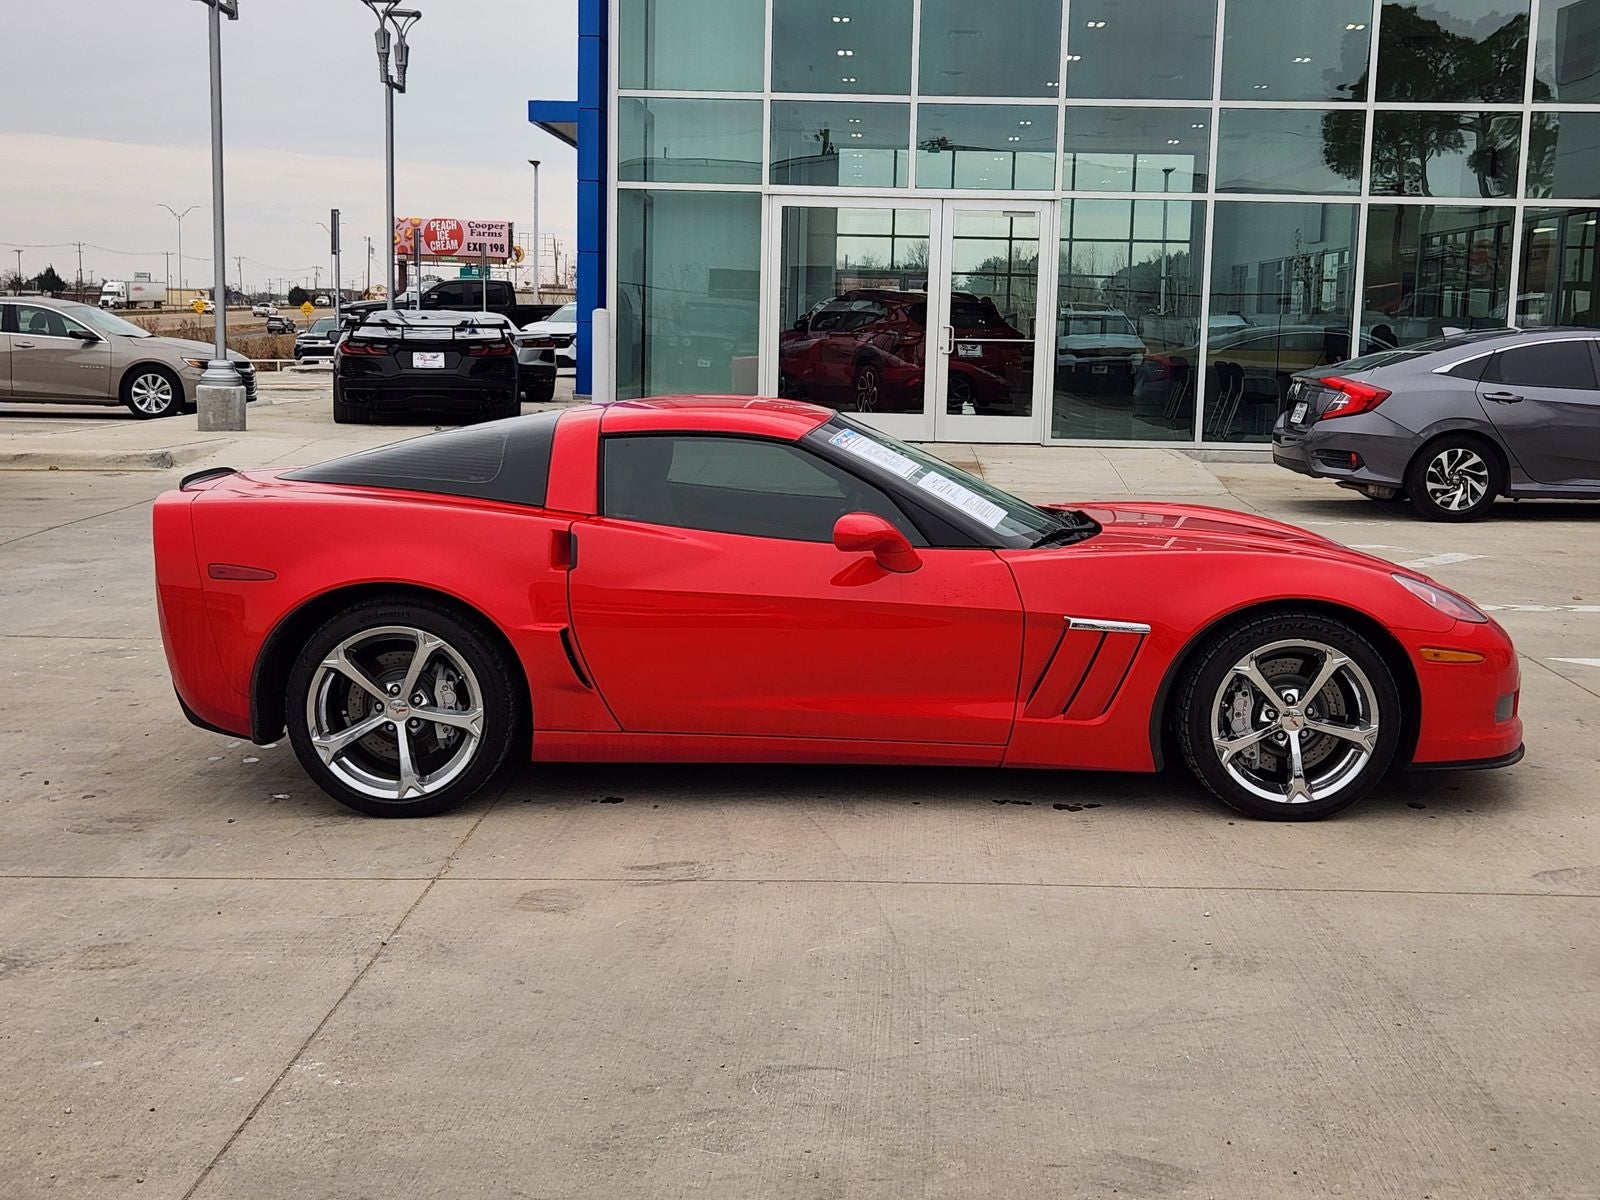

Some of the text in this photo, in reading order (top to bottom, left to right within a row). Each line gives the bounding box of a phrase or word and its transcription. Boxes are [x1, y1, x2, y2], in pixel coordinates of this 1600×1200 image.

[430, 220, 457, 231] PEACH
[467, 221, 505, 230] Cooper
[436, 230, 450, 240] ICE
[470, 229, 502, 238] Farms
[430, 239, 459, 251] CREAM
[467, 242, 505, 253] EXI 198
